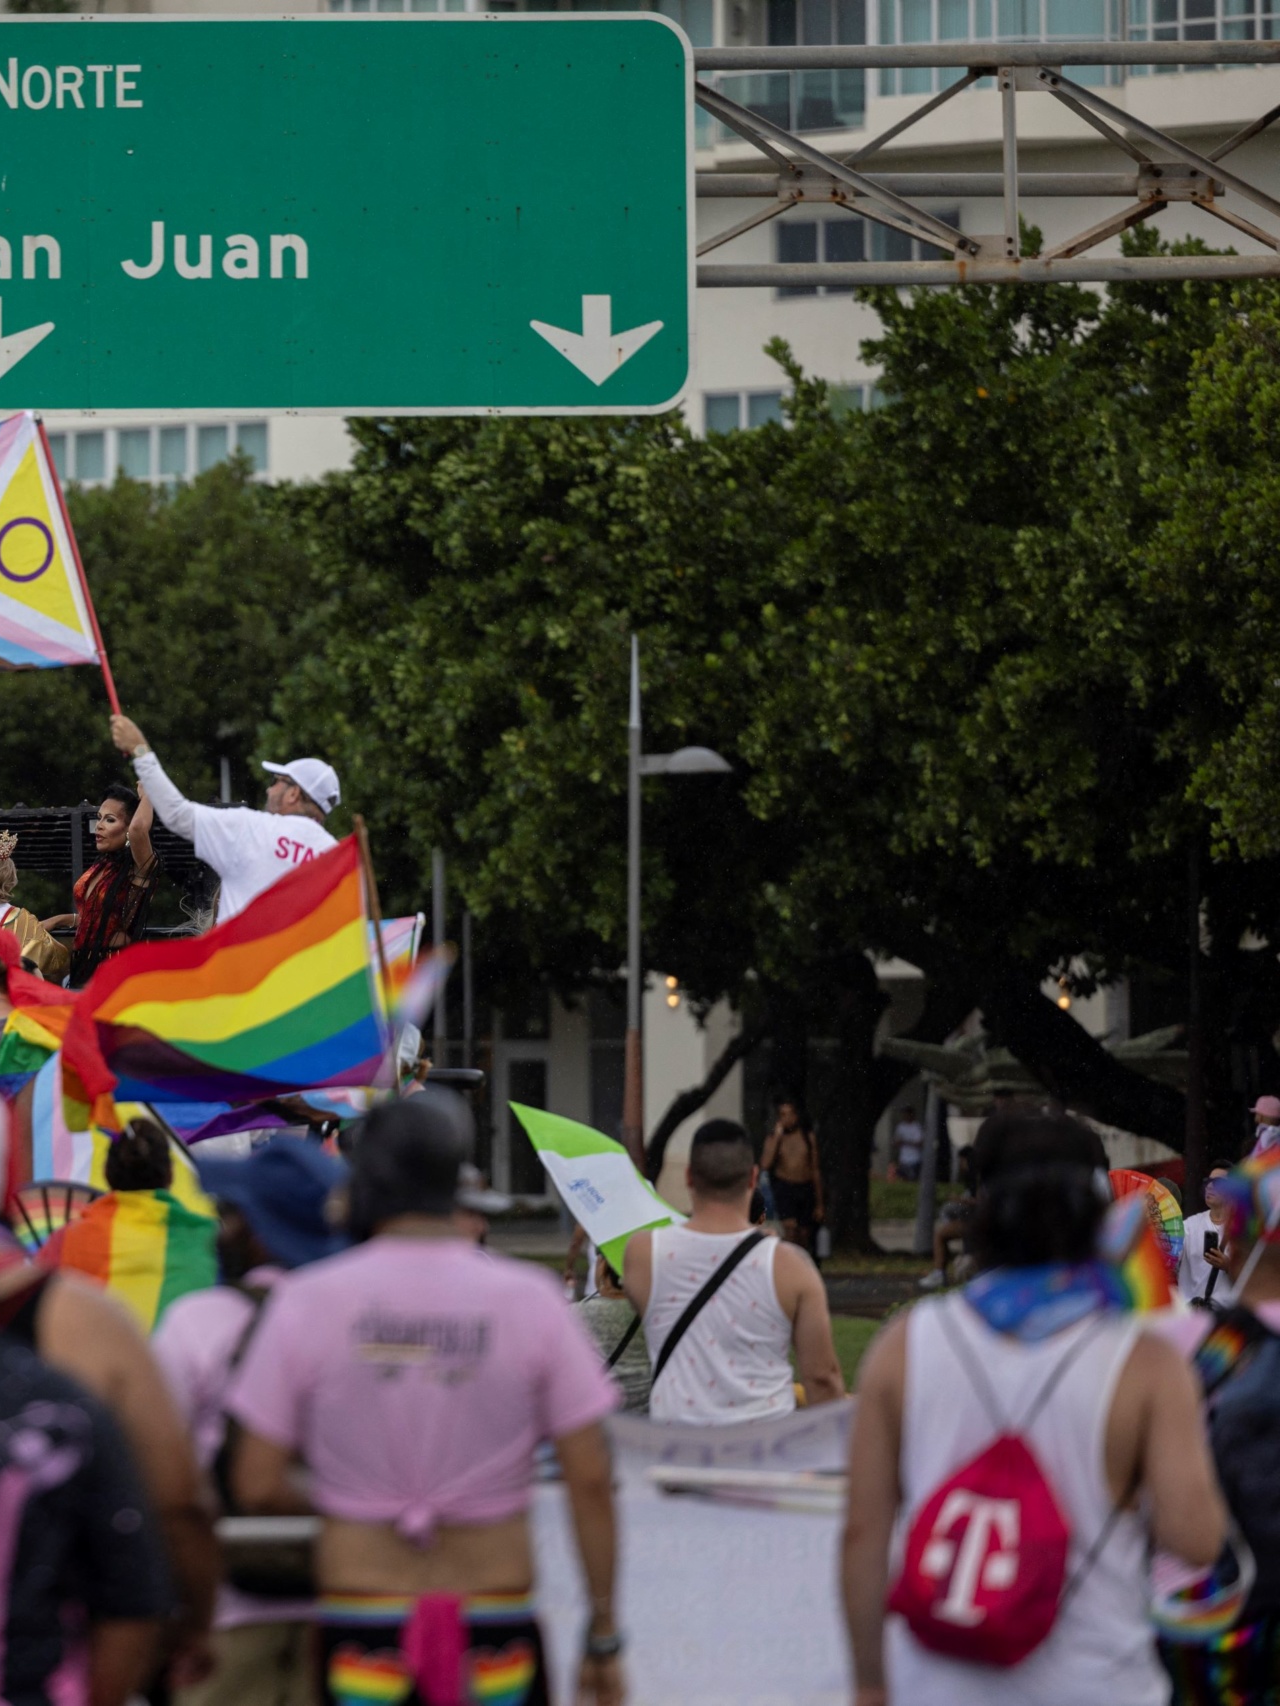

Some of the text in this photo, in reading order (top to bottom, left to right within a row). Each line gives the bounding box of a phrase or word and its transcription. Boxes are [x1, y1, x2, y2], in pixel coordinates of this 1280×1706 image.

[121, 220, 310, 280] Juan
[273, 836, 320, 866] STA
[919, 1487, 1021, 1628] T
